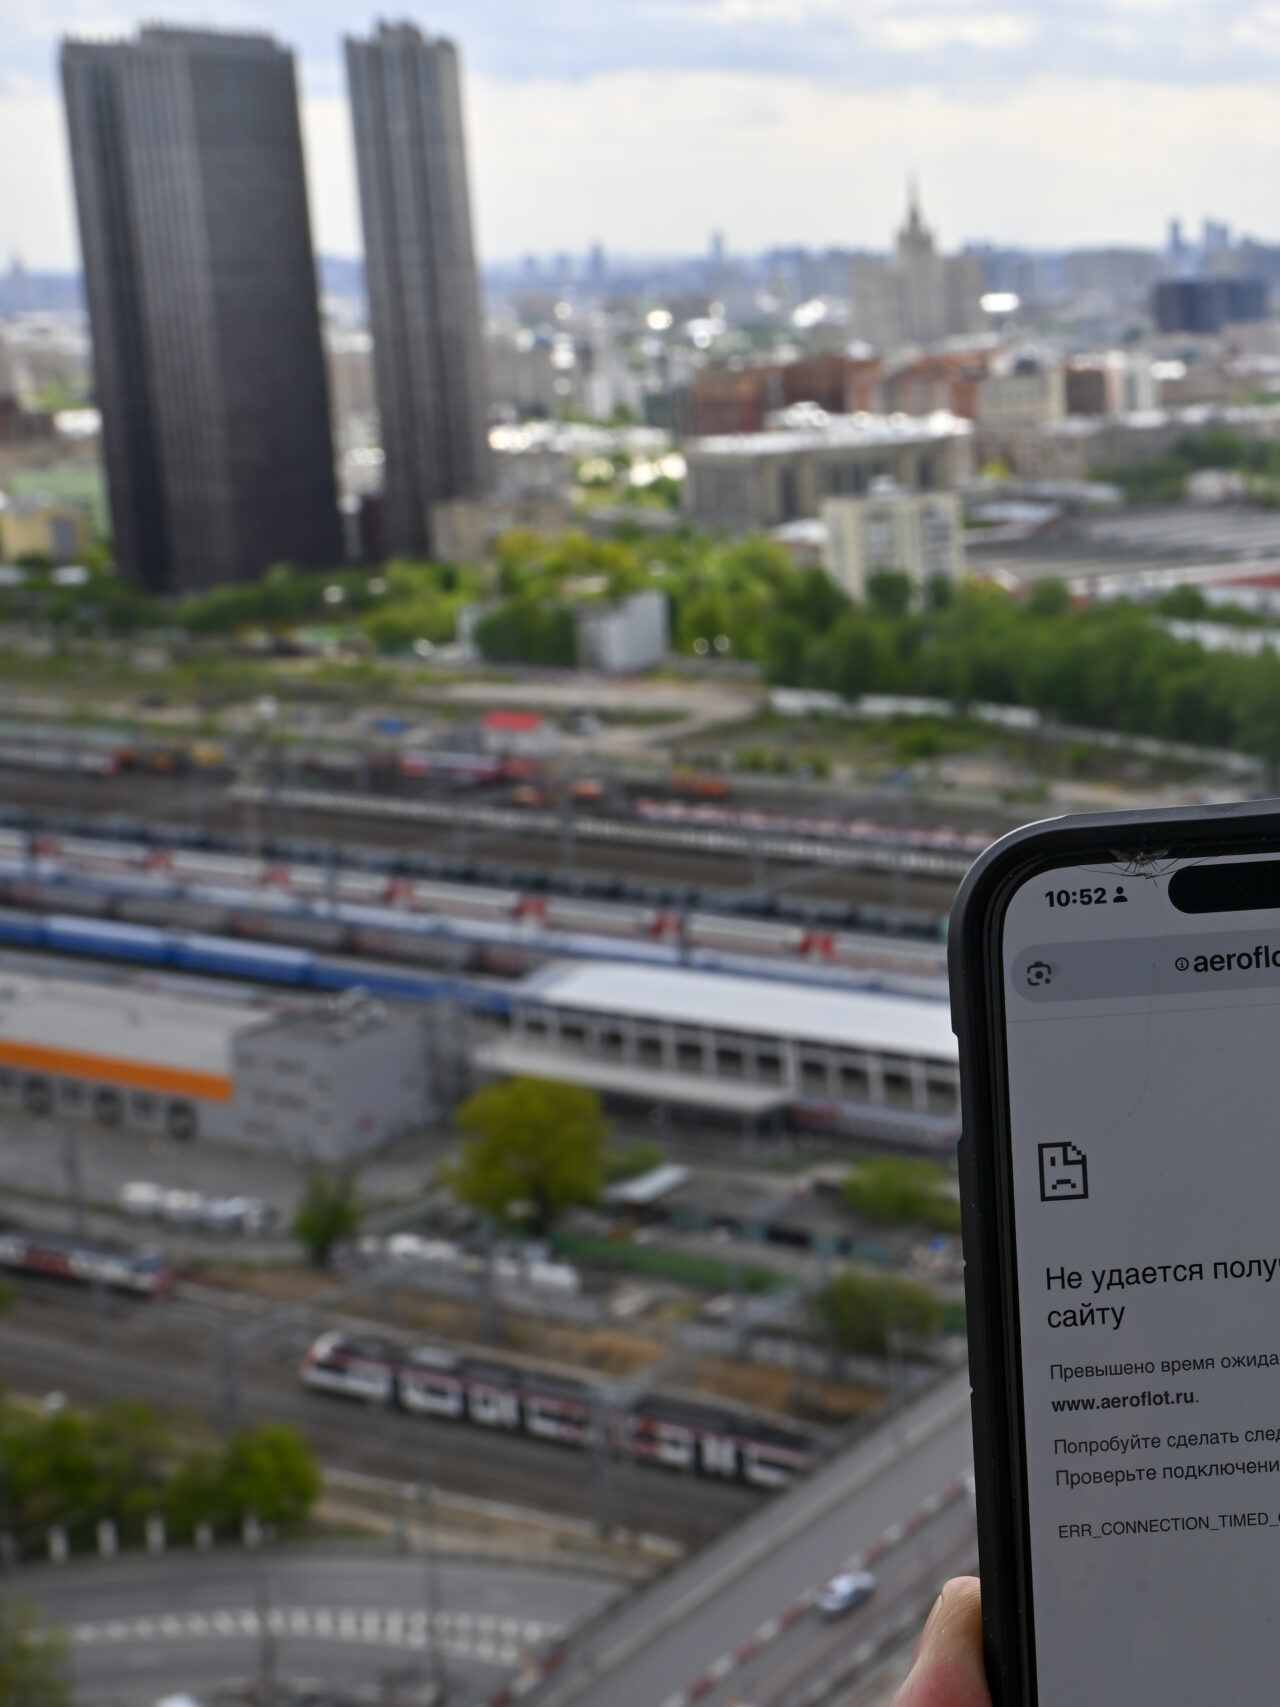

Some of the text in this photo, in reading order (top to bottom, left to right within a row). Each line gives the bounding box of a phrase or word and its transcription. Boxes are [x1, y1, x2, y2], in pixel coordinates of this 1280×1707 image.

[1044, 886, 1108, 908] 10:52
[1045, 1266, 1083, 1291] Не
[1090, 1263, 1204, 1294] удается
[1047, 1302, 1126, 1331] сайту
[1050, 1361, 1155, 1383] Превышено
[1160, 1357, 1215, 1376] время
[1050, 1390, 1199, 1413] www.aeroflot.ru.
[1054, 1433, 1161, 1457] Попробуйте
[1166, 1431, 1240, 1449] сделать
[1055, 1467, 1157, 1490] Проверьте
